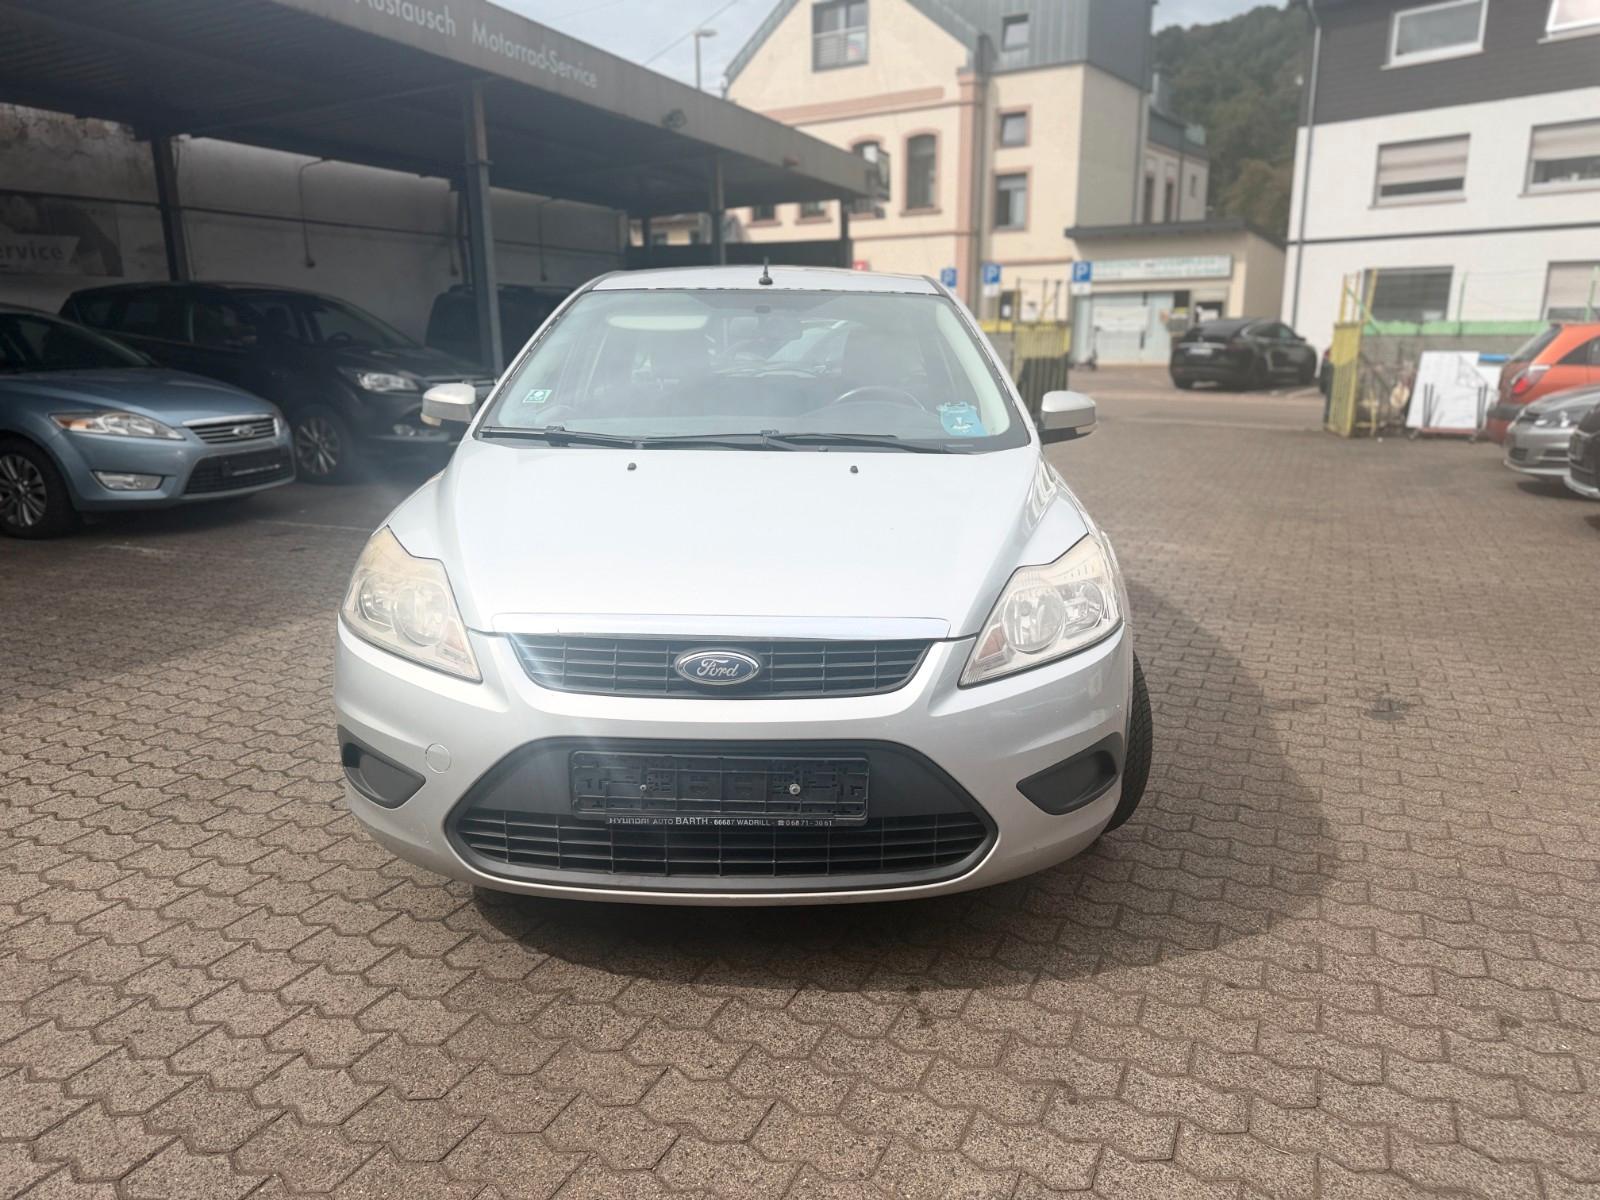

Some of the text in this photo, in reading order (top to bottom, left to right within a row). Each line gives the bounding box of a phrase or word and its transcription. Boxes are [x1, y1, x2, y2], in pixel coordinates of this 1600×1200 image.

[471, 17, 598, 89] Motorrad-Service
[1076, 263, 1089, 281] P
[697, 658, 740, 677] Ford
[652, 818, 674, 826] AUTO
[675, 816, 709, 826] BARTH
[736, 819, 771, 827] WADRILL
